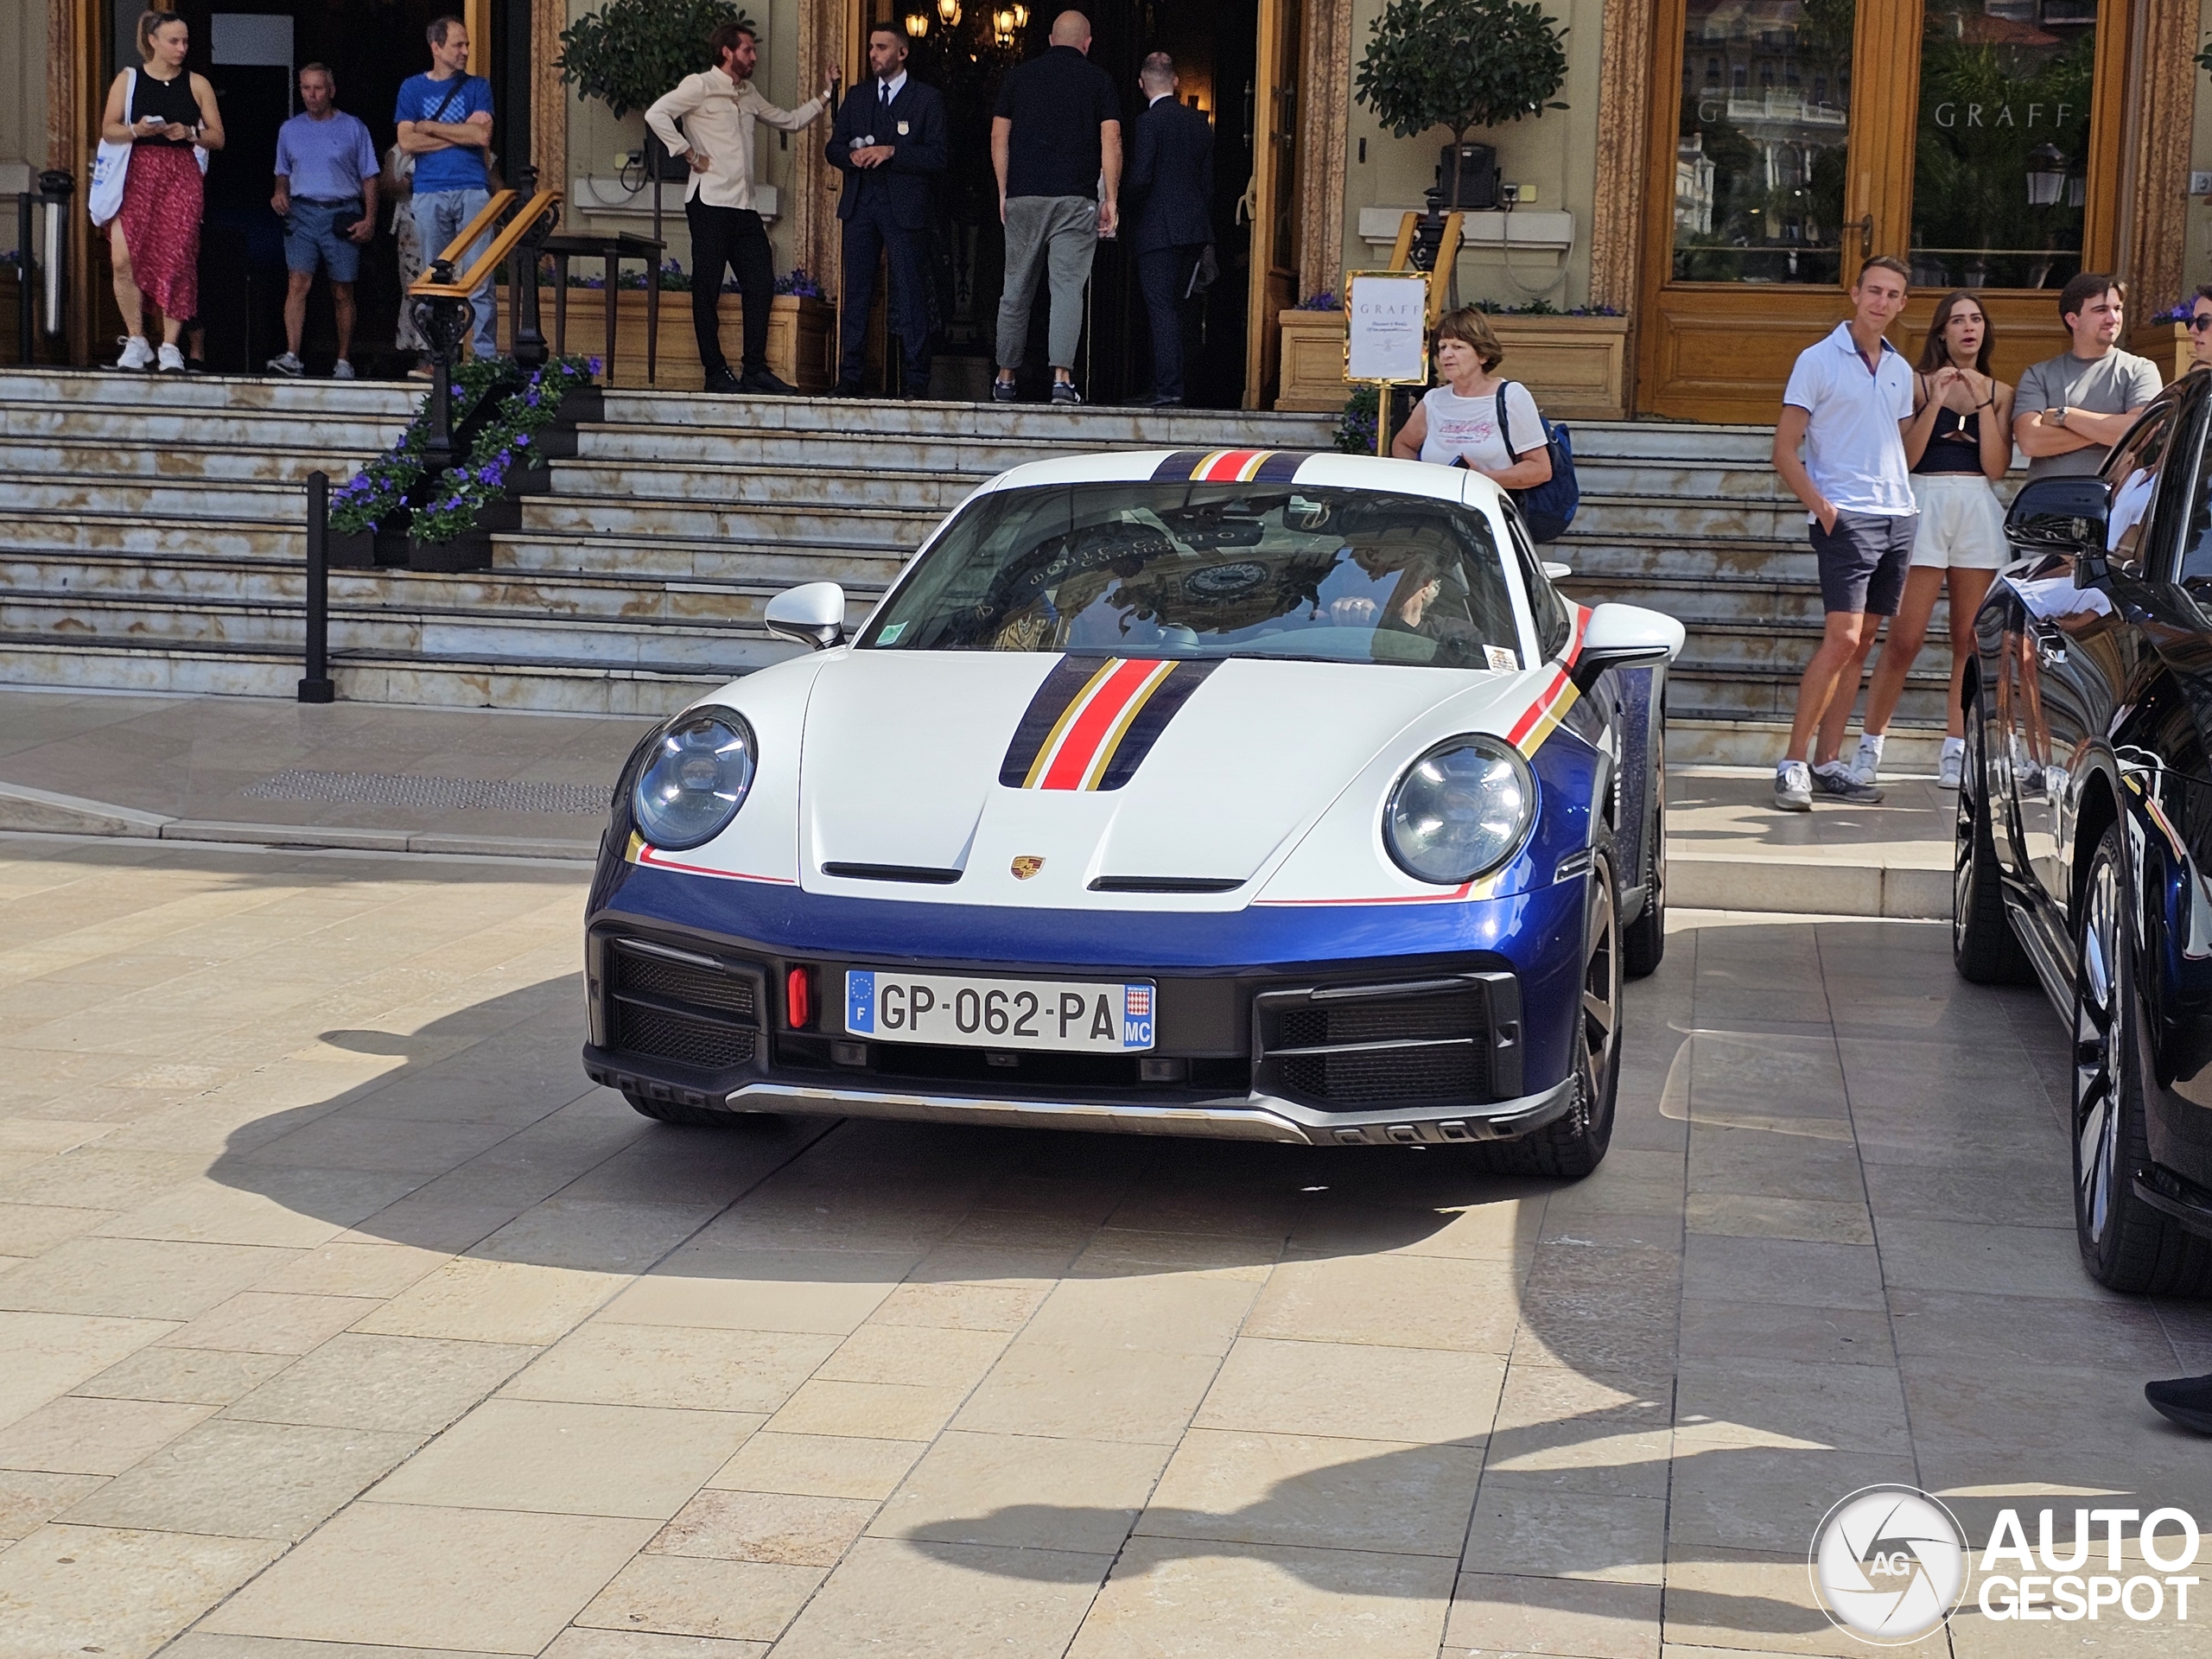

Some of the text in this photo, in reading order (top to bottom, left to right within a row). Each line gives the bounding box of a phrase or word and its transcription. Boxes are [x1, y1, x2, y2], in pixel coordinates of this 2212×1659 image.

[1935, 101, 2073, 128] GRAFF
[1360, 303, 1420, 315] GRAFF
[857, 1007, 866, 1020] F
[880, 984, 1116, 1040] GP-062-PA
[1125, 1021, 1150, 1042] MC
